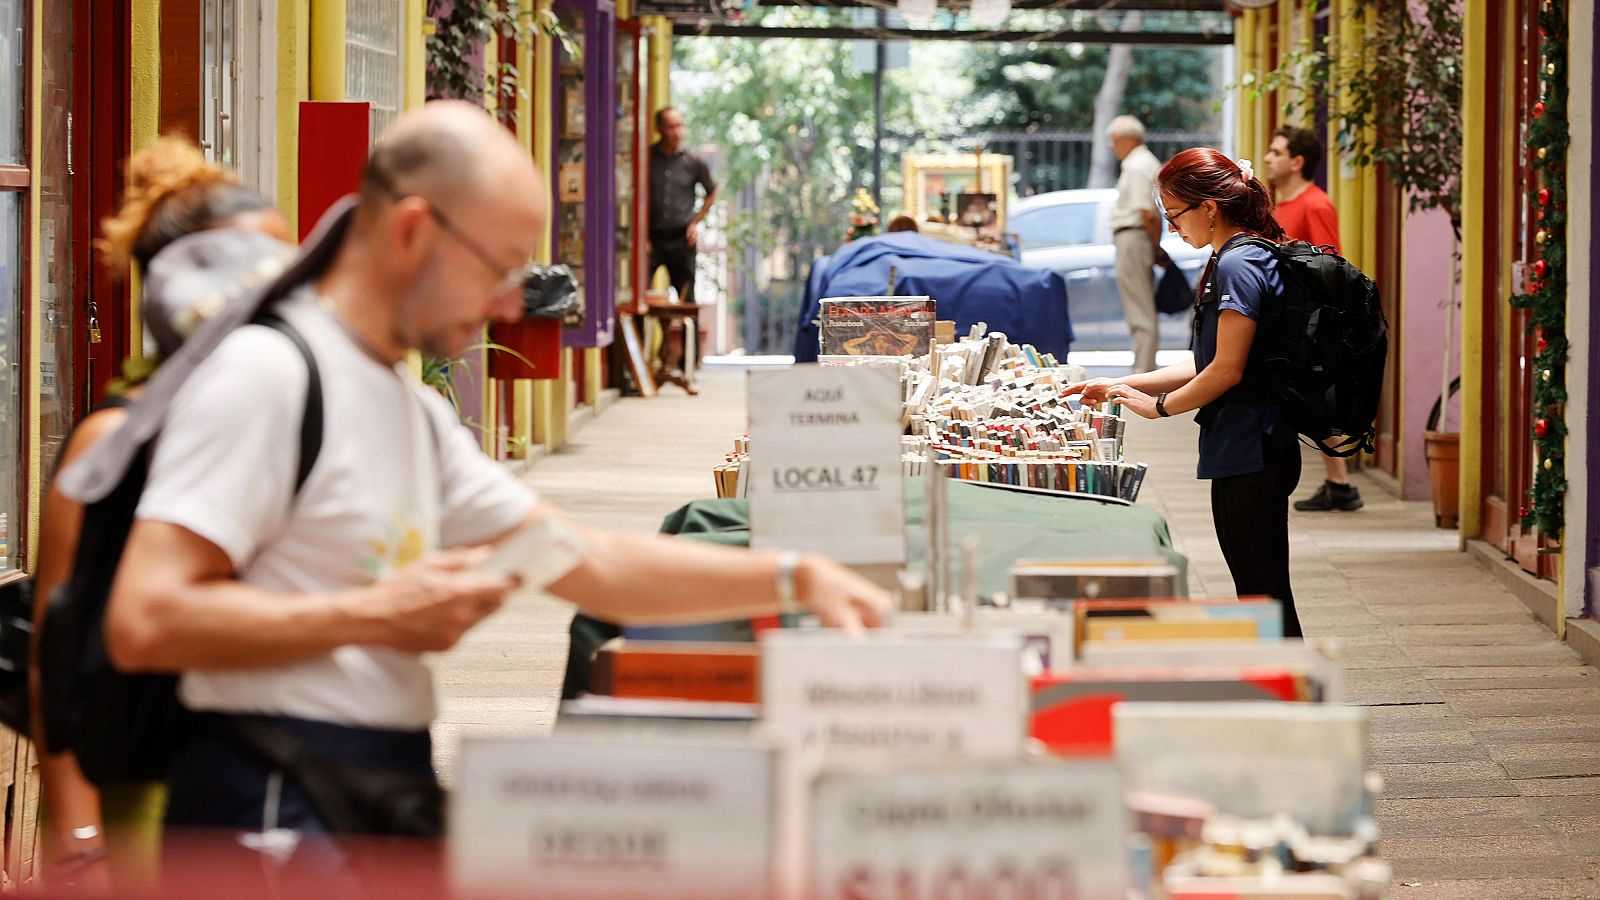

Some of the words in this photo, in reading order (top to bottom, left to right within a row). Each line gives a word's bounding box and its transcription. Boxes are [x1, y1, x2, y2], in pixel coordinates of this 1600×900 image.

[828, 305, 879, 318] EDVARD
[789, 411, 861, 426] TERMINA
[772, 468, 845, 489] LOCAL
[851, 466, 879, 484] 47
